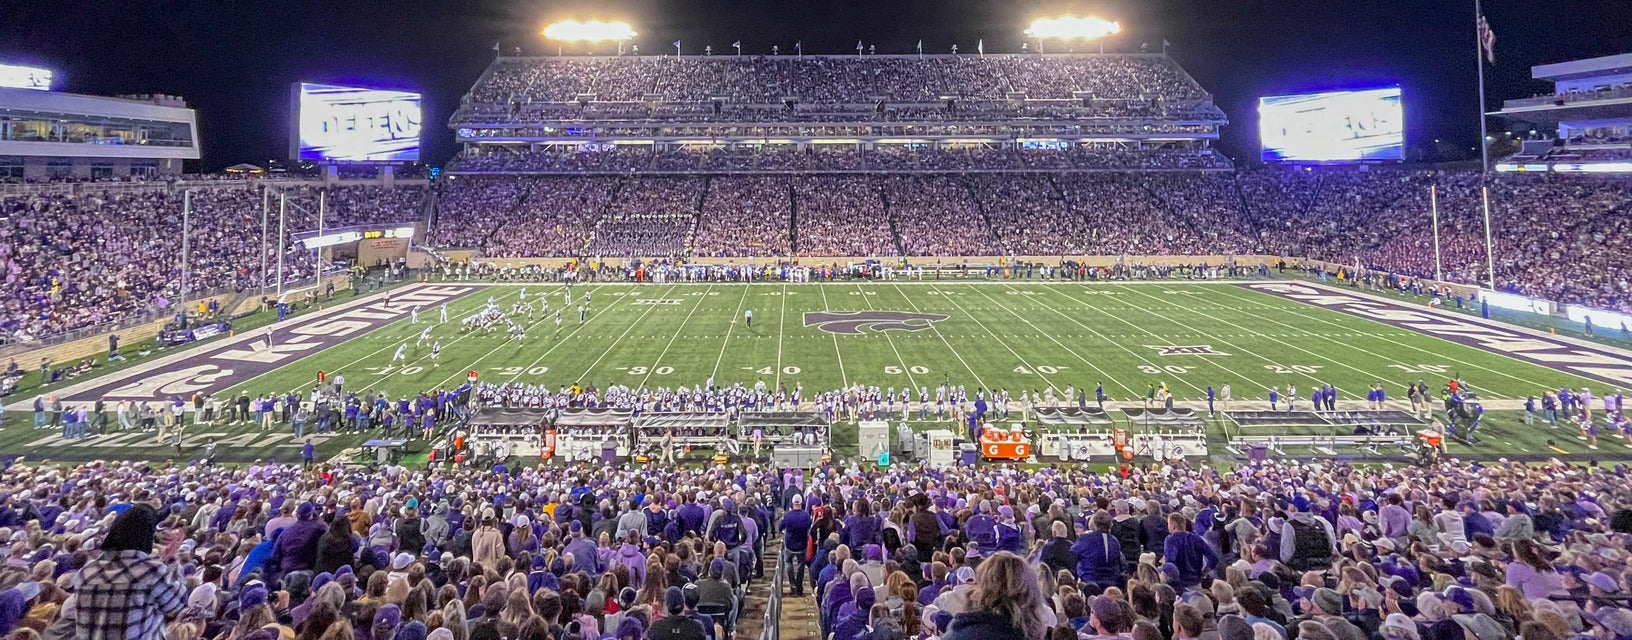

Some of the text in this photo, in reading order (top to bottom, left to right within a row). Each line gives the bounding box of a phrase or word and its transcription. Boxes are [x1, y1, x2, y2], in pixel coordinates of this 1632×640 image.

[209, 286, 474, 363] K-STATE
[370, 366, 423, 375] 10
[498, 366, 549, 375] 20
[627, 366, 675, 375] 30
[756, 366, 801, 375] 40
[884, 366, 929, 374] 50
[1013, 365, 1058, 374] 40
[1137, 365, 1188, 374] 30
[1263, 365, 1318, 374] 20
[988, 444, 999, 455] G
[1015, 444, 1025, 455] G
